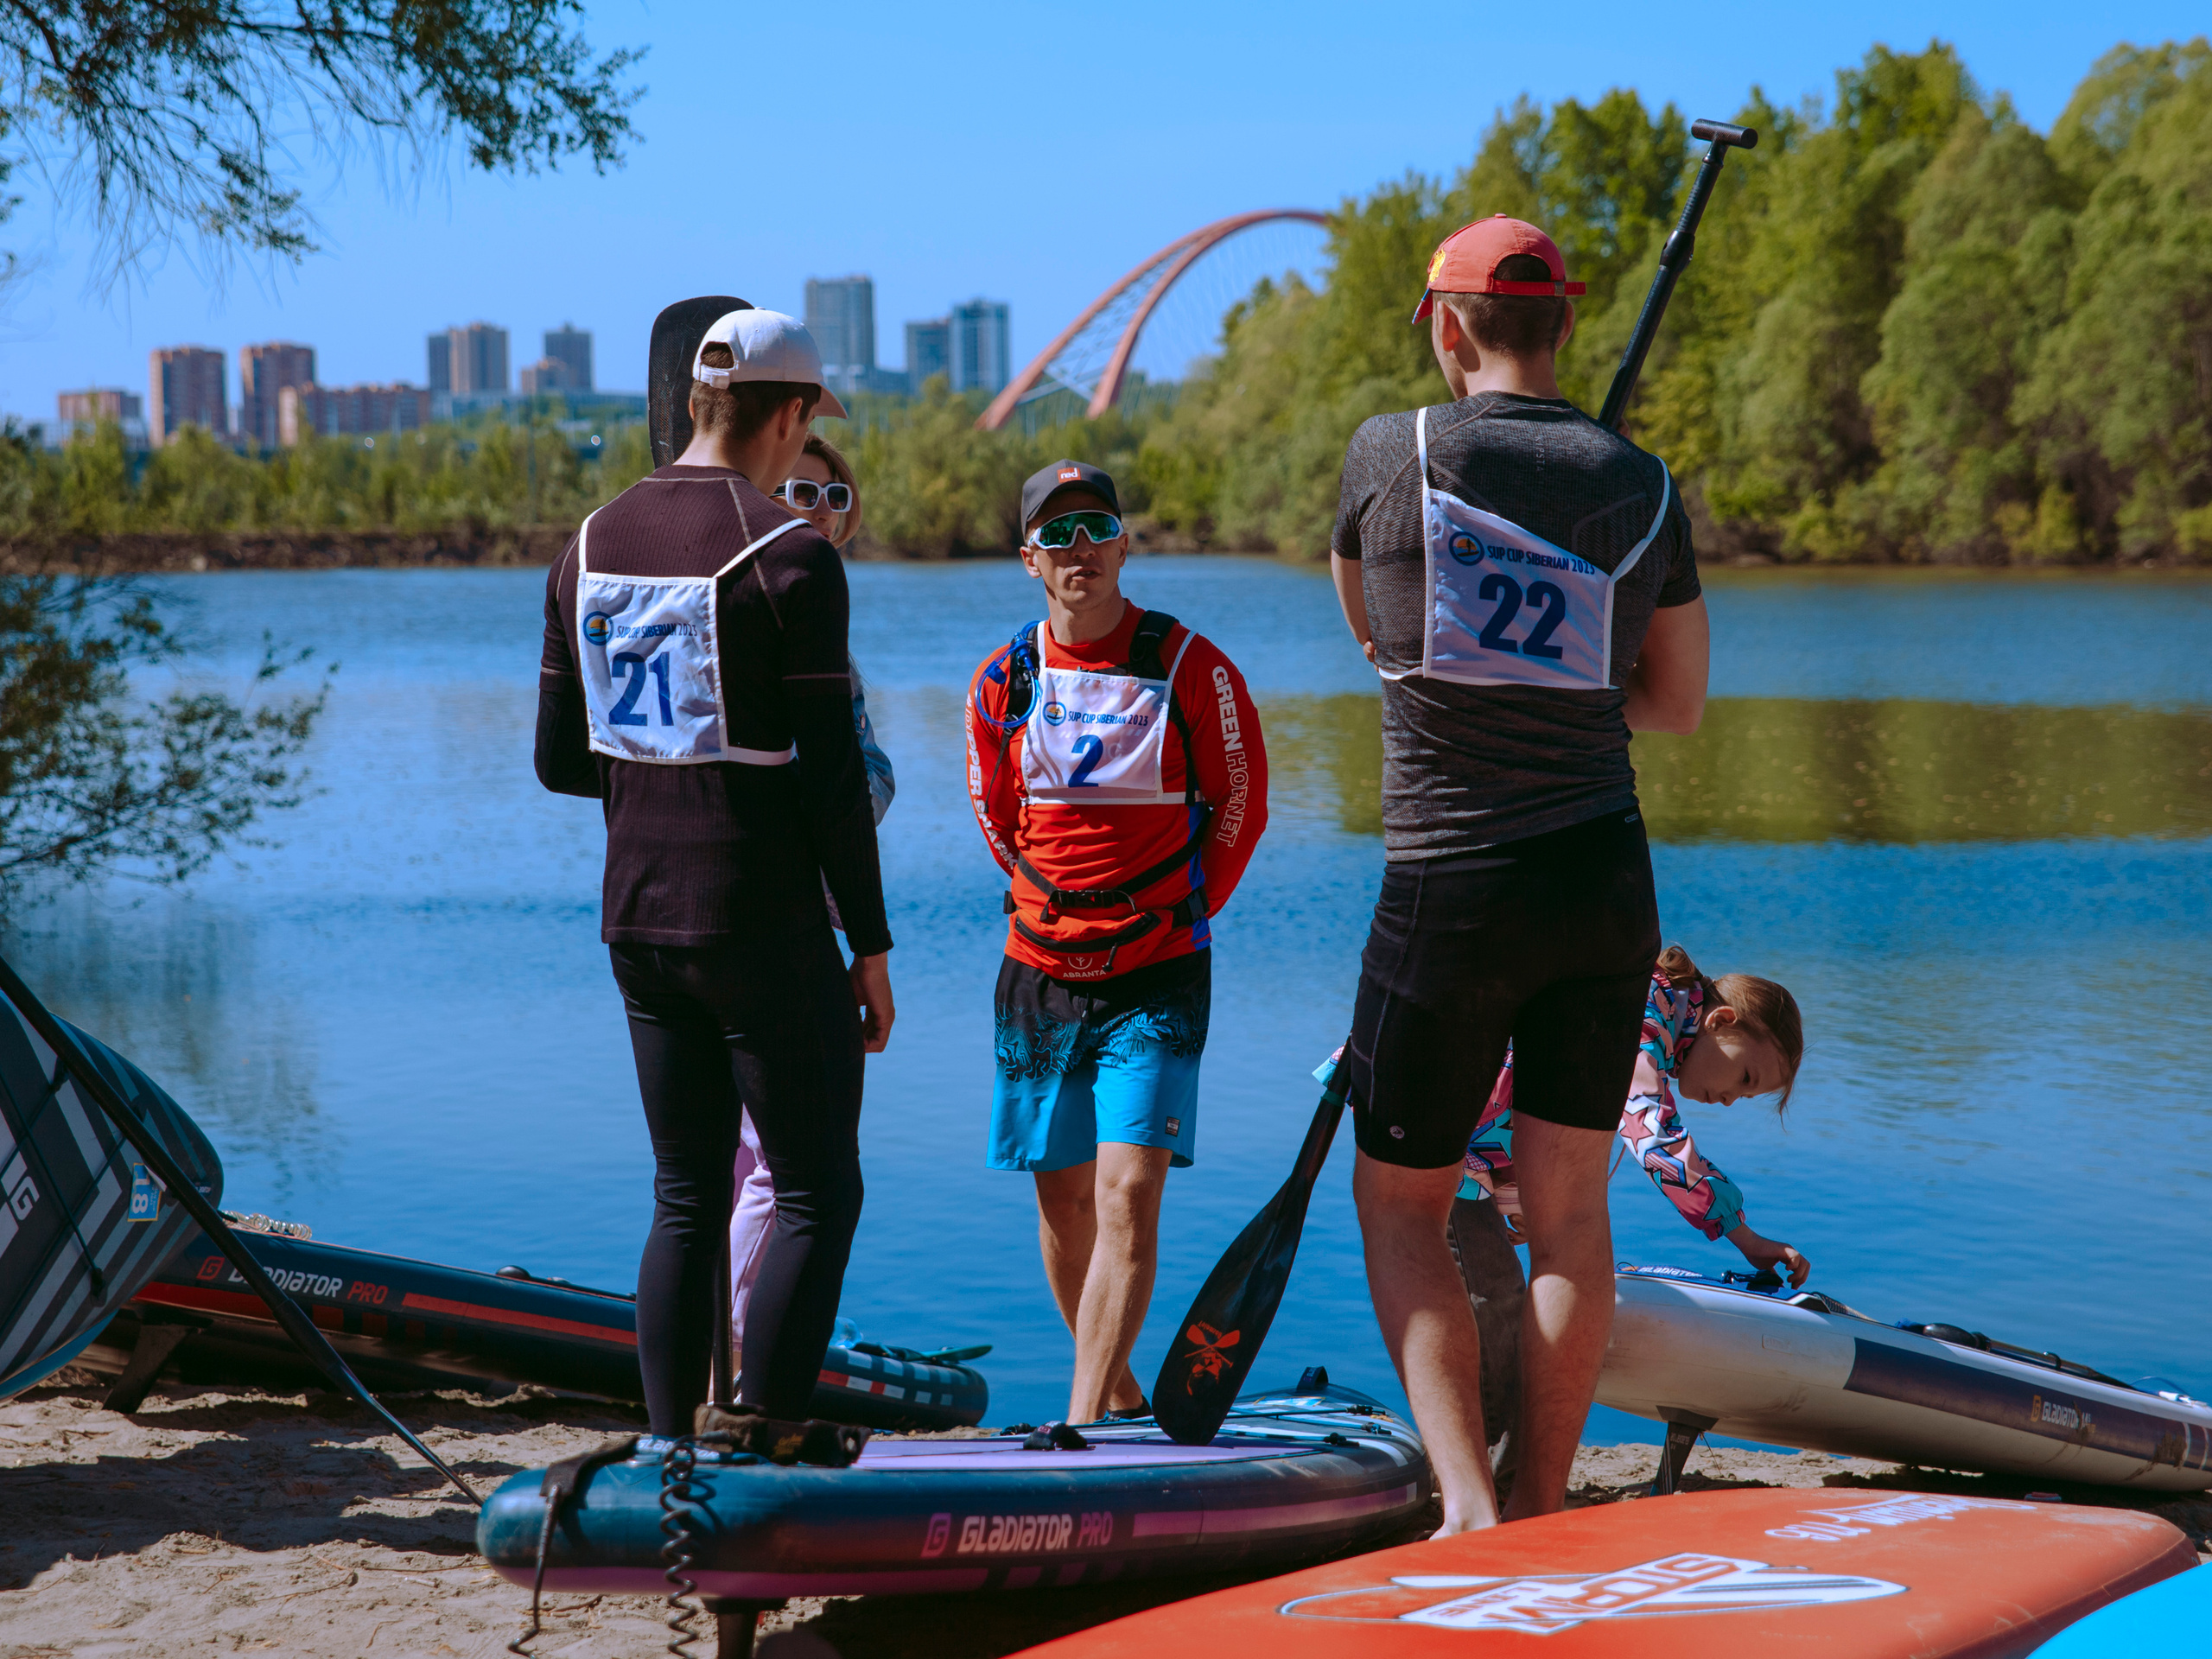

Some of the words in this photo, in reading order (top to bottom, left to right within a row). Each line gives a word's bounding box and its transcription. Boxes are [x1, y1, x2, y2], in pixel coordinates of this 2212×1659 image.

[1060, 467, 1078, 480] red
[1487, 545, 1505, 560] SUP
[1507, 548, 1524, 563] CUP
[1526, 551, 1570, 571] SIBERIAN
[1479, 573, 1566, 659] 22
[641, 623, 677, 639] SIBERIAN
[677, 623, 697, 637] 2023
[608, 652, 674, 727] 21
[1068, 711, 1081, 722] SUP
[1082, 713, 1096, 723] CUP
[1096, 713, 1128, 724] SIBERIAN
[1128, 715, 1148, 726] 2023
[1068, 734, 1103, 787] 2
[1063, 969, 1106, 978] ABRANTA
[228, 1266, 343, 1298] DIATOR
[347, 1281, 388, 1305] PRO
[636, 1438, 721, 1461] GLADTOR
[957, 1514, 1073, 1554] GLADIATOR
[1077, 1511, 1114, 1548] PRO
[1427, 1585, 1543, 1618] LINE
